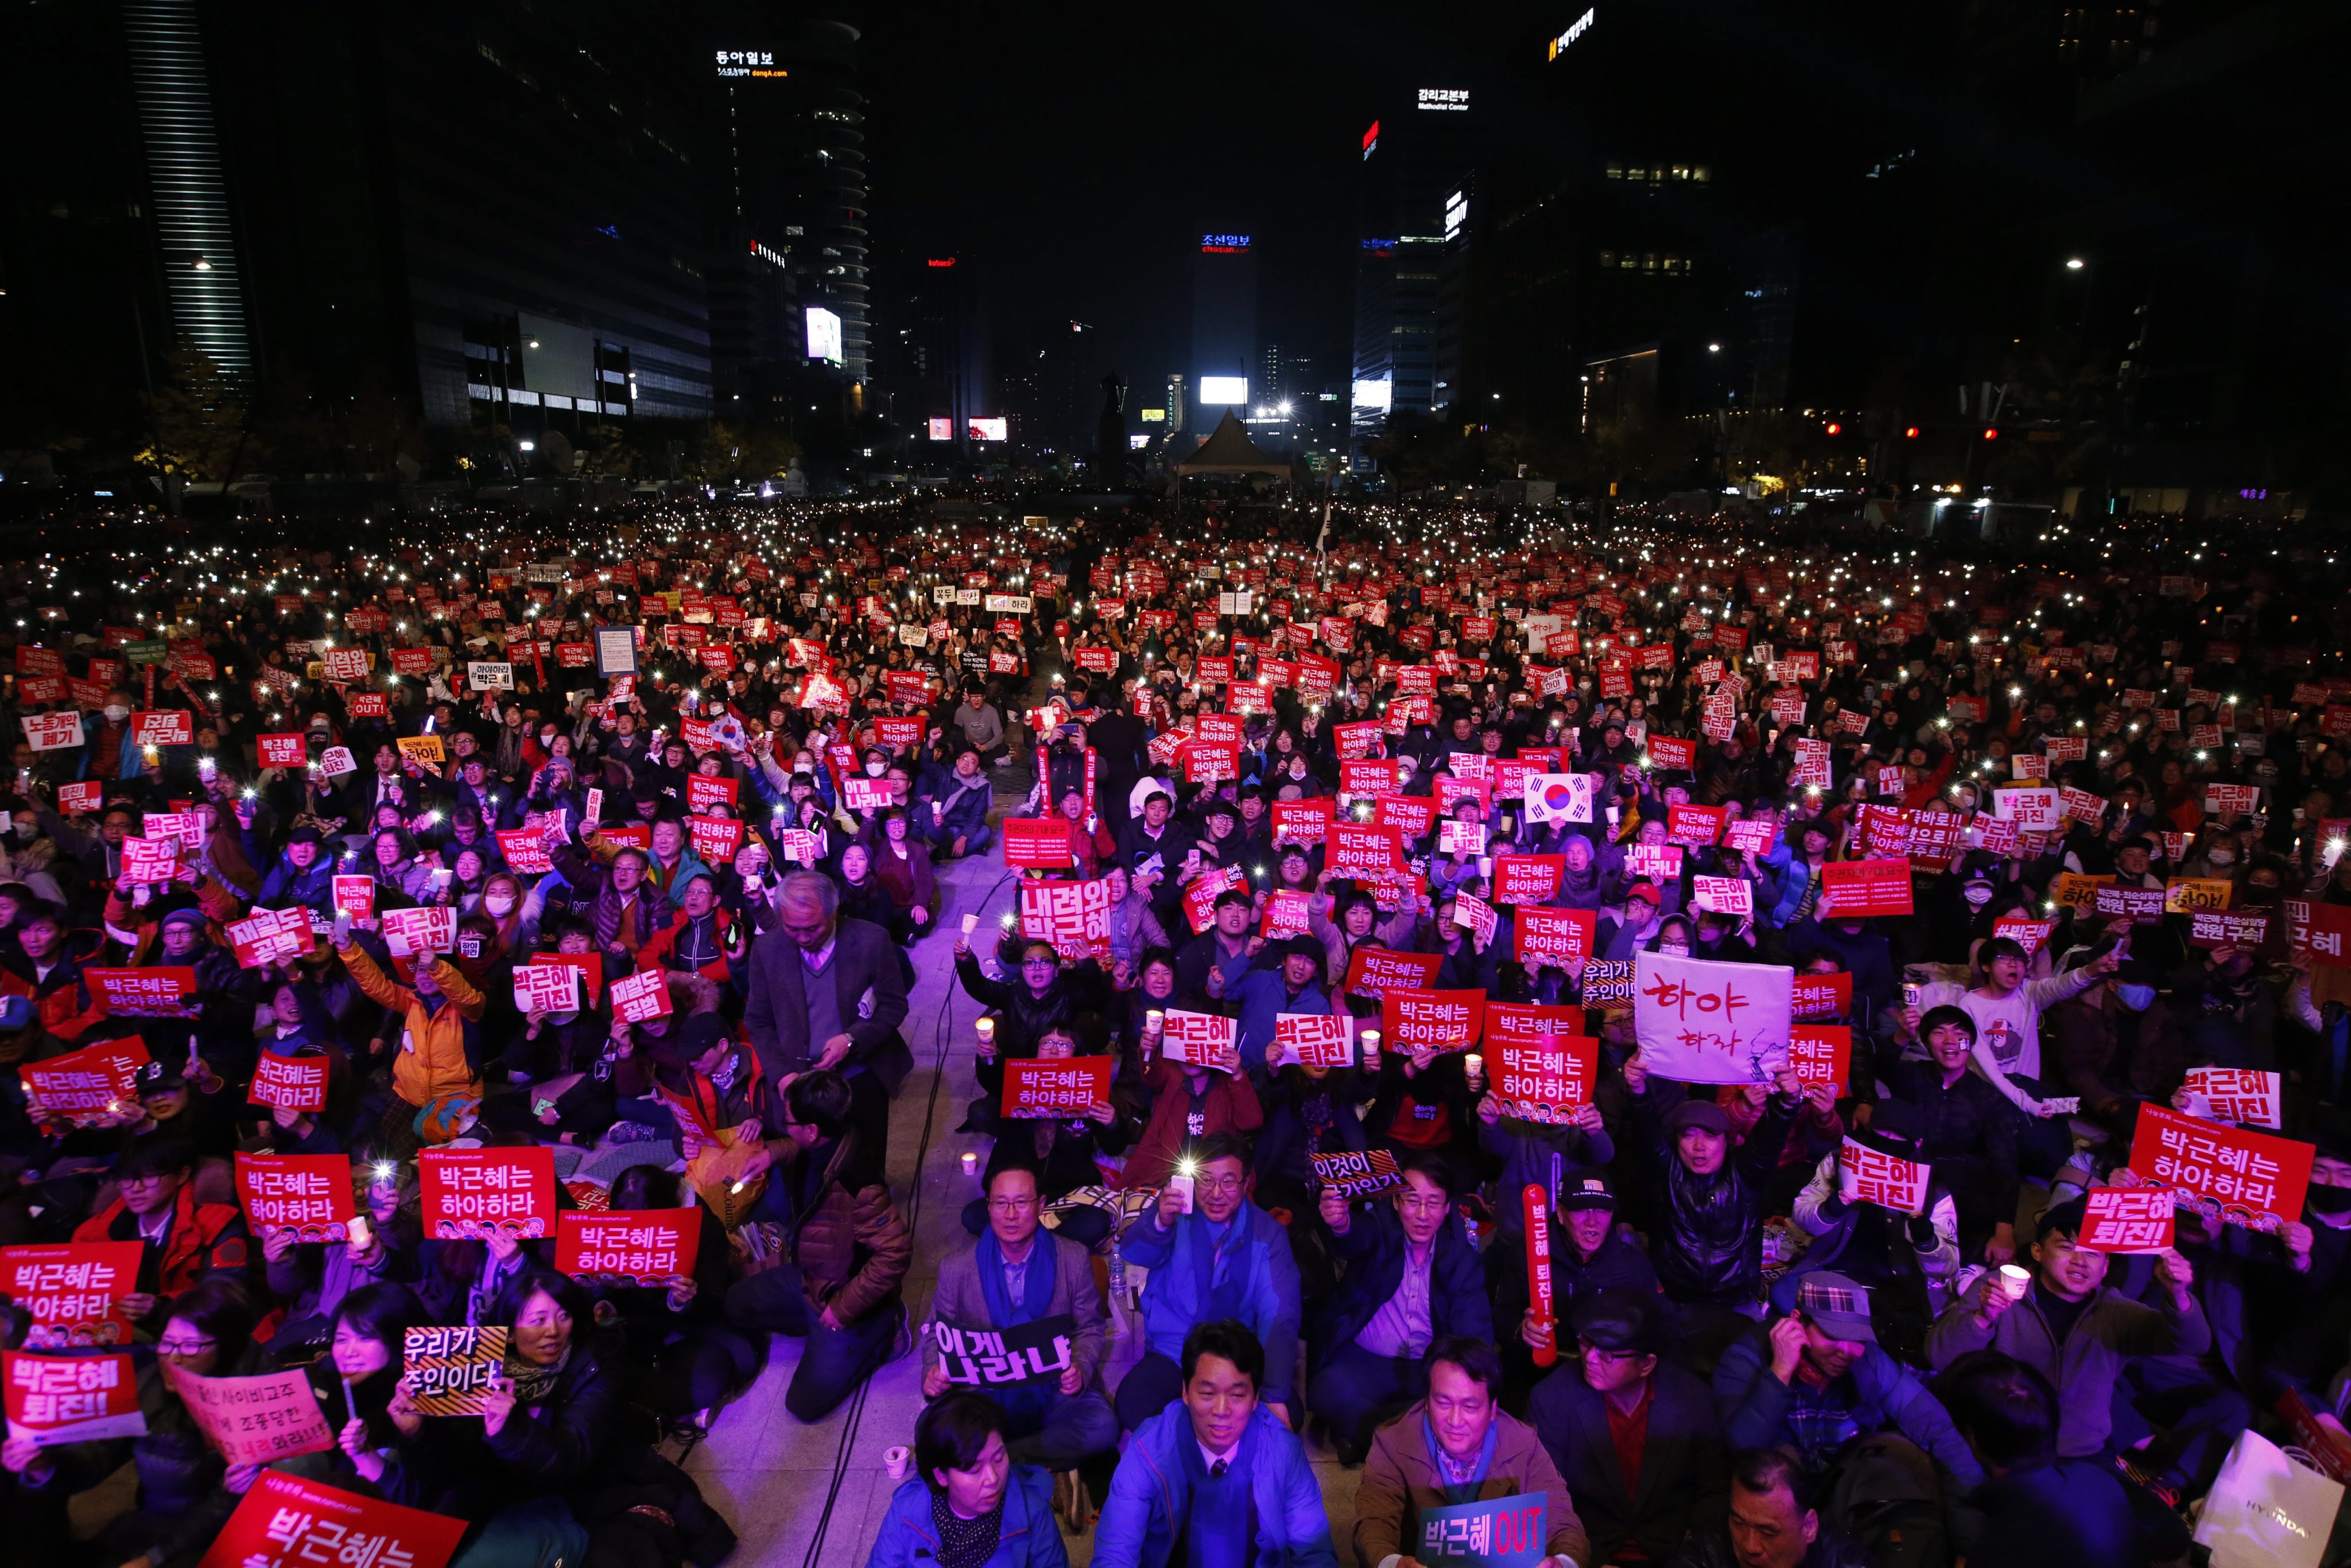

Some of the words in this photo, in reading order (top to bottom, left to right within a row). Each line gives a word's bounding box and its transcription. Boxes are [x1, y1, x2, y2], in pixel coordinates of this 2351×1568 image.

[716, 51, 773, 65] 동아일보
[752, 69, 787, 77] dongA.com
[1418, 89, 1469, 102] 감리교본부
[1201, 235, 1251, 246] 조선일보
[937, 589, 951, 600] 꼭두
[1363, 590, 1379, 599] 하야하라
[1365, 584, 1380, 593] 박근혜는
[1012, 600, 1028, 610] 하라
[1530, 621, 1553, 634] 하야
[1549, 633, 1574, 645] 퇴진하라
[1551, 643, 1574, 653] 박근혜!
[324, 649, 367, 665] 내려와
[991, 653, 1018, 665] 박근혜
[1201, 661, 1228, 670] 박근혜는
[324, 662, 368, 679] 박근혜
[476, 665, 509, 673] 하야하라
[994, 663, 1012, 672] 퇴진
[1200, 669, 1228, 678] 하야하라
[1403, 670, 1431, 678] 박근혜는
[1402, 679, 1431, 687] 하야하라
[1546, 680, 1561, 690] 하야
[359, 695, 381, 704] 박근혜
[355, 704, 384, 714] OUT!
[30, 715, 77, 732] 노동개악
[882, 723, 918, 732] 박근혜는
[42, 729, 72, 746] 폐기
[262, 738, 297, 751] 박근혜
[882, 732, 918, 743] 하야하라
[269, 750, 292, 762] 퇴진
[1654, 741, 1687, 755] 박근혜는
[1653, 753, 1686, 764] 하야하라
[1350, 767, 1390, 778] 박근혜는
[844, 779, 871, 794] 이게
[1349, 779, 1390, 790] 하야하라
[2208, 786, 2253, 799] 박근혜
[589, 791, 599, 818] 하야
[845, 791, 893, 809] 나라냐
[2002, 794, 2051, 809] 박근혜
[2219, 800, 2250, 813] 퇴진
[1282, 810, 1325, 822] 박근혜는
[2013, 810, 2044, 824] 퇴진
[693, 821, 736, 840] 퇴진하라
[1007, 824, 1033, 833] 주권자의
[1036, 825, 1048, 834] 7대
[1051, 825, 1065, 834] 요구
[1729, 821, 1772, 836] 재벌도
[124, 837, 179, 861] 박근혜
[693, 838, 731, 856] 박근혜!
[1339, 832, 1391, 850] 박근혜는
[1732, 835, 1762, 851] 공범
[1337, 849, 1391, 867] 하야하라
[127, 859, 175, 883] 퇴진
[1507, 864, 1554, 878] 박근혜는
[1828, 868, 1864, 879] 주권자의
[1867, 867, 1883, 876] 7대
[1887, 865, 1906, 875] 요구
[339, 886, 370, 897] 박근혜
[1506, 878, 1553, 892] 하야하라
[1695, 879, 1745, 895] 박근혜
[2098, 888, 2164, 900] 박근혜·최순실일당
[343, 898, 366, 910] 퇴진!
[1023, 879, 1111, 917] 내려와
[1713, 894, 1748, 914] 퇴진
[2096, 898, 2125, 913] 전원
[2127, 901, 2162, 915] 구속!
[231, 908, 304, 947] 재벌도
[386, 909, 451, 936] 박근혜
[1024, 913, 1111, 944] 박근혜
[1526, 917, 1582, 936] 박근혜는
[2194, 913, 2267, 927] 박근혜·최순실일당
[407, 930, 449, 953] 퇴진
[2191, 922, 2225, 940] 전원
[2226, 926, 2264, 943] 구속!
[253, 930, 301, 964] 공범
[1524, 934, 1582, 954] 하야하라
[514, 967, 571, 991] 박근혜
[1584, 962, 1628, 981] 우리가
[103, 977, 179, 993] 박근혜는
[611, 969, 662, 1005] 재벌도
[532, 990, 572, 1011] 퇴진
[1643, 972, 1750, 1024] 하야
[623, 994, 661, 1021] 공범
[1400, 1001, 1469, 1022] 박근혜는
[1165, 1016, 1229, 1041] 박근혜
[1277, 1015, 1345, 1043] 박근혜
[1398, 1022, 1468, 1042] 하야하라
[1500, 1015, 1569, 1035] 박근혜는
[1677, 1029, 1743, 1057] 하라
[1299, 1043, 1345, 1066] 퇴진
[1503, 1048, 1583, 1076] 박근혜는
[259, 1057, 323, 1084] 박근혜는
[1022, 1070, 1095, 1088] 박근혜는
[32, 1072, 109, 1089] 박근혜는
[1503, 1076, 1583, 1101] 하야하라
[2185, 1070, 2269, 1096] 박근혜
[255, 1079, 322, 1107] 퇴진하라
[1019, 1089, 1094, 1107] 하야하라
[2209, 1097, 2271, 1124] 퇴진
[2146, 1108, 2172, 1121] 나눔문화
[2172, 1117, 2221, 1136] www.nanum.com
[2160, 1128, 2279, 1180] 박근혜는
[1315, 1153, 1371, 1177] 이것이
[1840, 1143, 1918, 1185] 박근혜
[249, 1171, 331, 1196] 박근혜는
[440, 1165, 533, 1190] 박근혜는
[2154, 1156, 2276, 1208] 하야하라
[1857, 1178, 1915, 1212] 퇴진
[251, 1198, 334, 1223] 하야하라
[441, 1191, 535, 1218] 하야하라
[2088, 1190, 2174, 1220] 박근혜
[581, 1227, 679, 1248] 박근혜는
[1533, 1204, 1547, 1257] 박근혜
[2089, 1221, 2164, 1247] 퇴진!
[578, 1251, 678, 1272] 하야하라
[15, 1262, 115, 1291] 박근혜는
[1537, 1264, 1551, 1316] 퇴진!
[405, 1328, 476, 1358] 우리가
[936, 1320, 1004, 1357] 이게
[939, 1335, 1070, 1385] 나라냐
[14, 1359, 119, 1391] 박근혜
[405, 1360, 498, 1395] 주인이다
[23, 1392, 108, 1423] 퇴진!
[240, 1407, 303, 1431] 조종당한
[267, 1507, 414, 1566] 박근혜는
[1426, 1514, 1490, 1556] 박근혜
[1495, 1507, 1543, 1555] OUT
